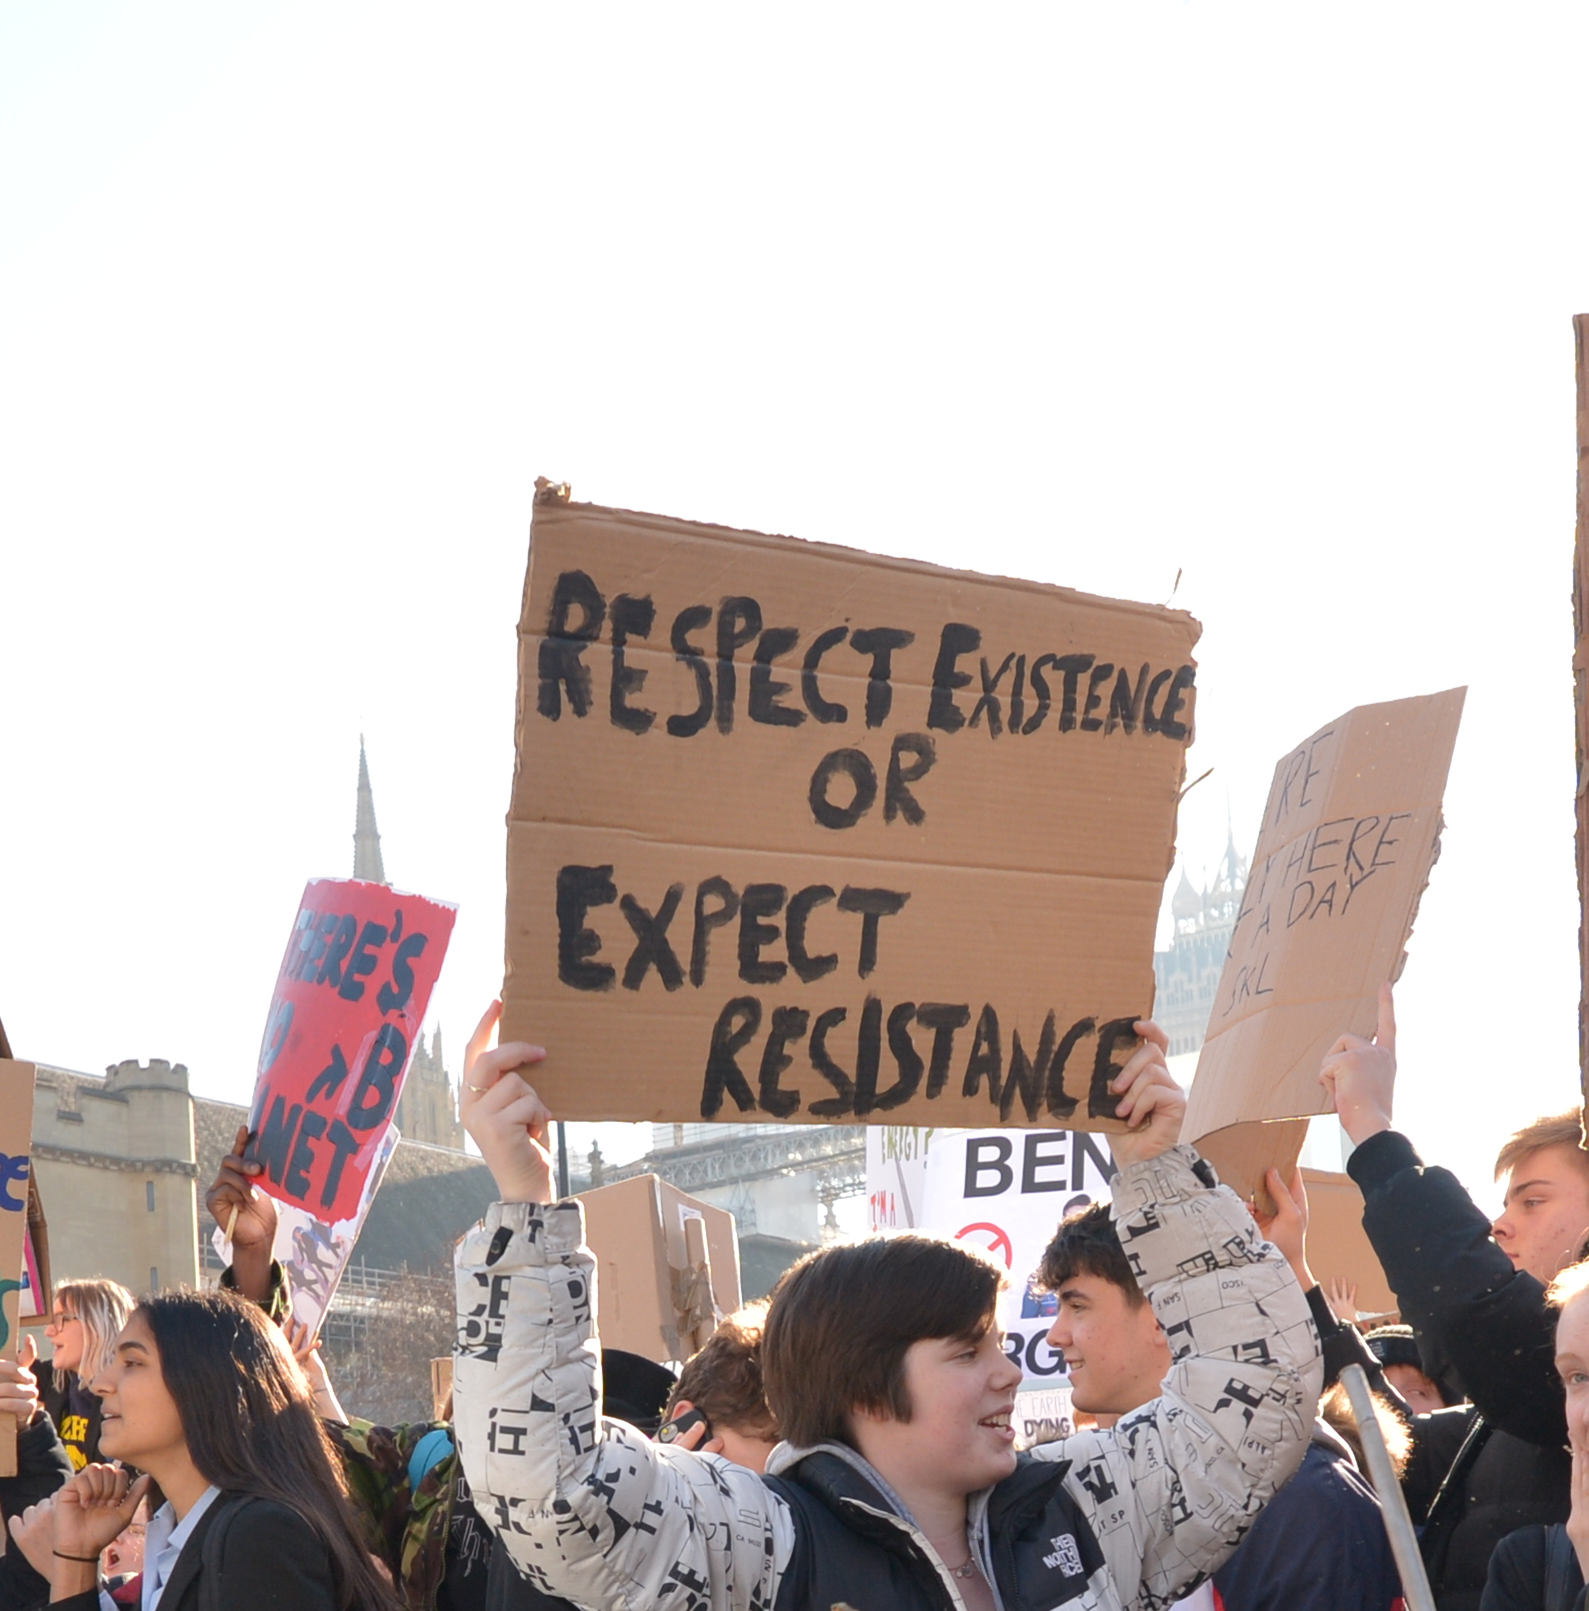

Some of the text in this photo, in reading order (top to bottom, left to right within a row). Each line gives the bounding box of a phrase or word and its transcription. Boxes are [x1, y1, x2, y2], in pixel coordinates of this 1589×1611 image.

[535, 570, 1198, 742] RESPECT EXISTENCE
[808, 731, 938, 831] OR
[555, 863, 911, 993] EXPECT
[1286, 865, 1378, 929] DAY
[699, 990, 1143, 1124] RESISTANCE
[1023, 1416, 1071, 1438] DYING
[1031, 1395, 1068, 1418] EARTH
